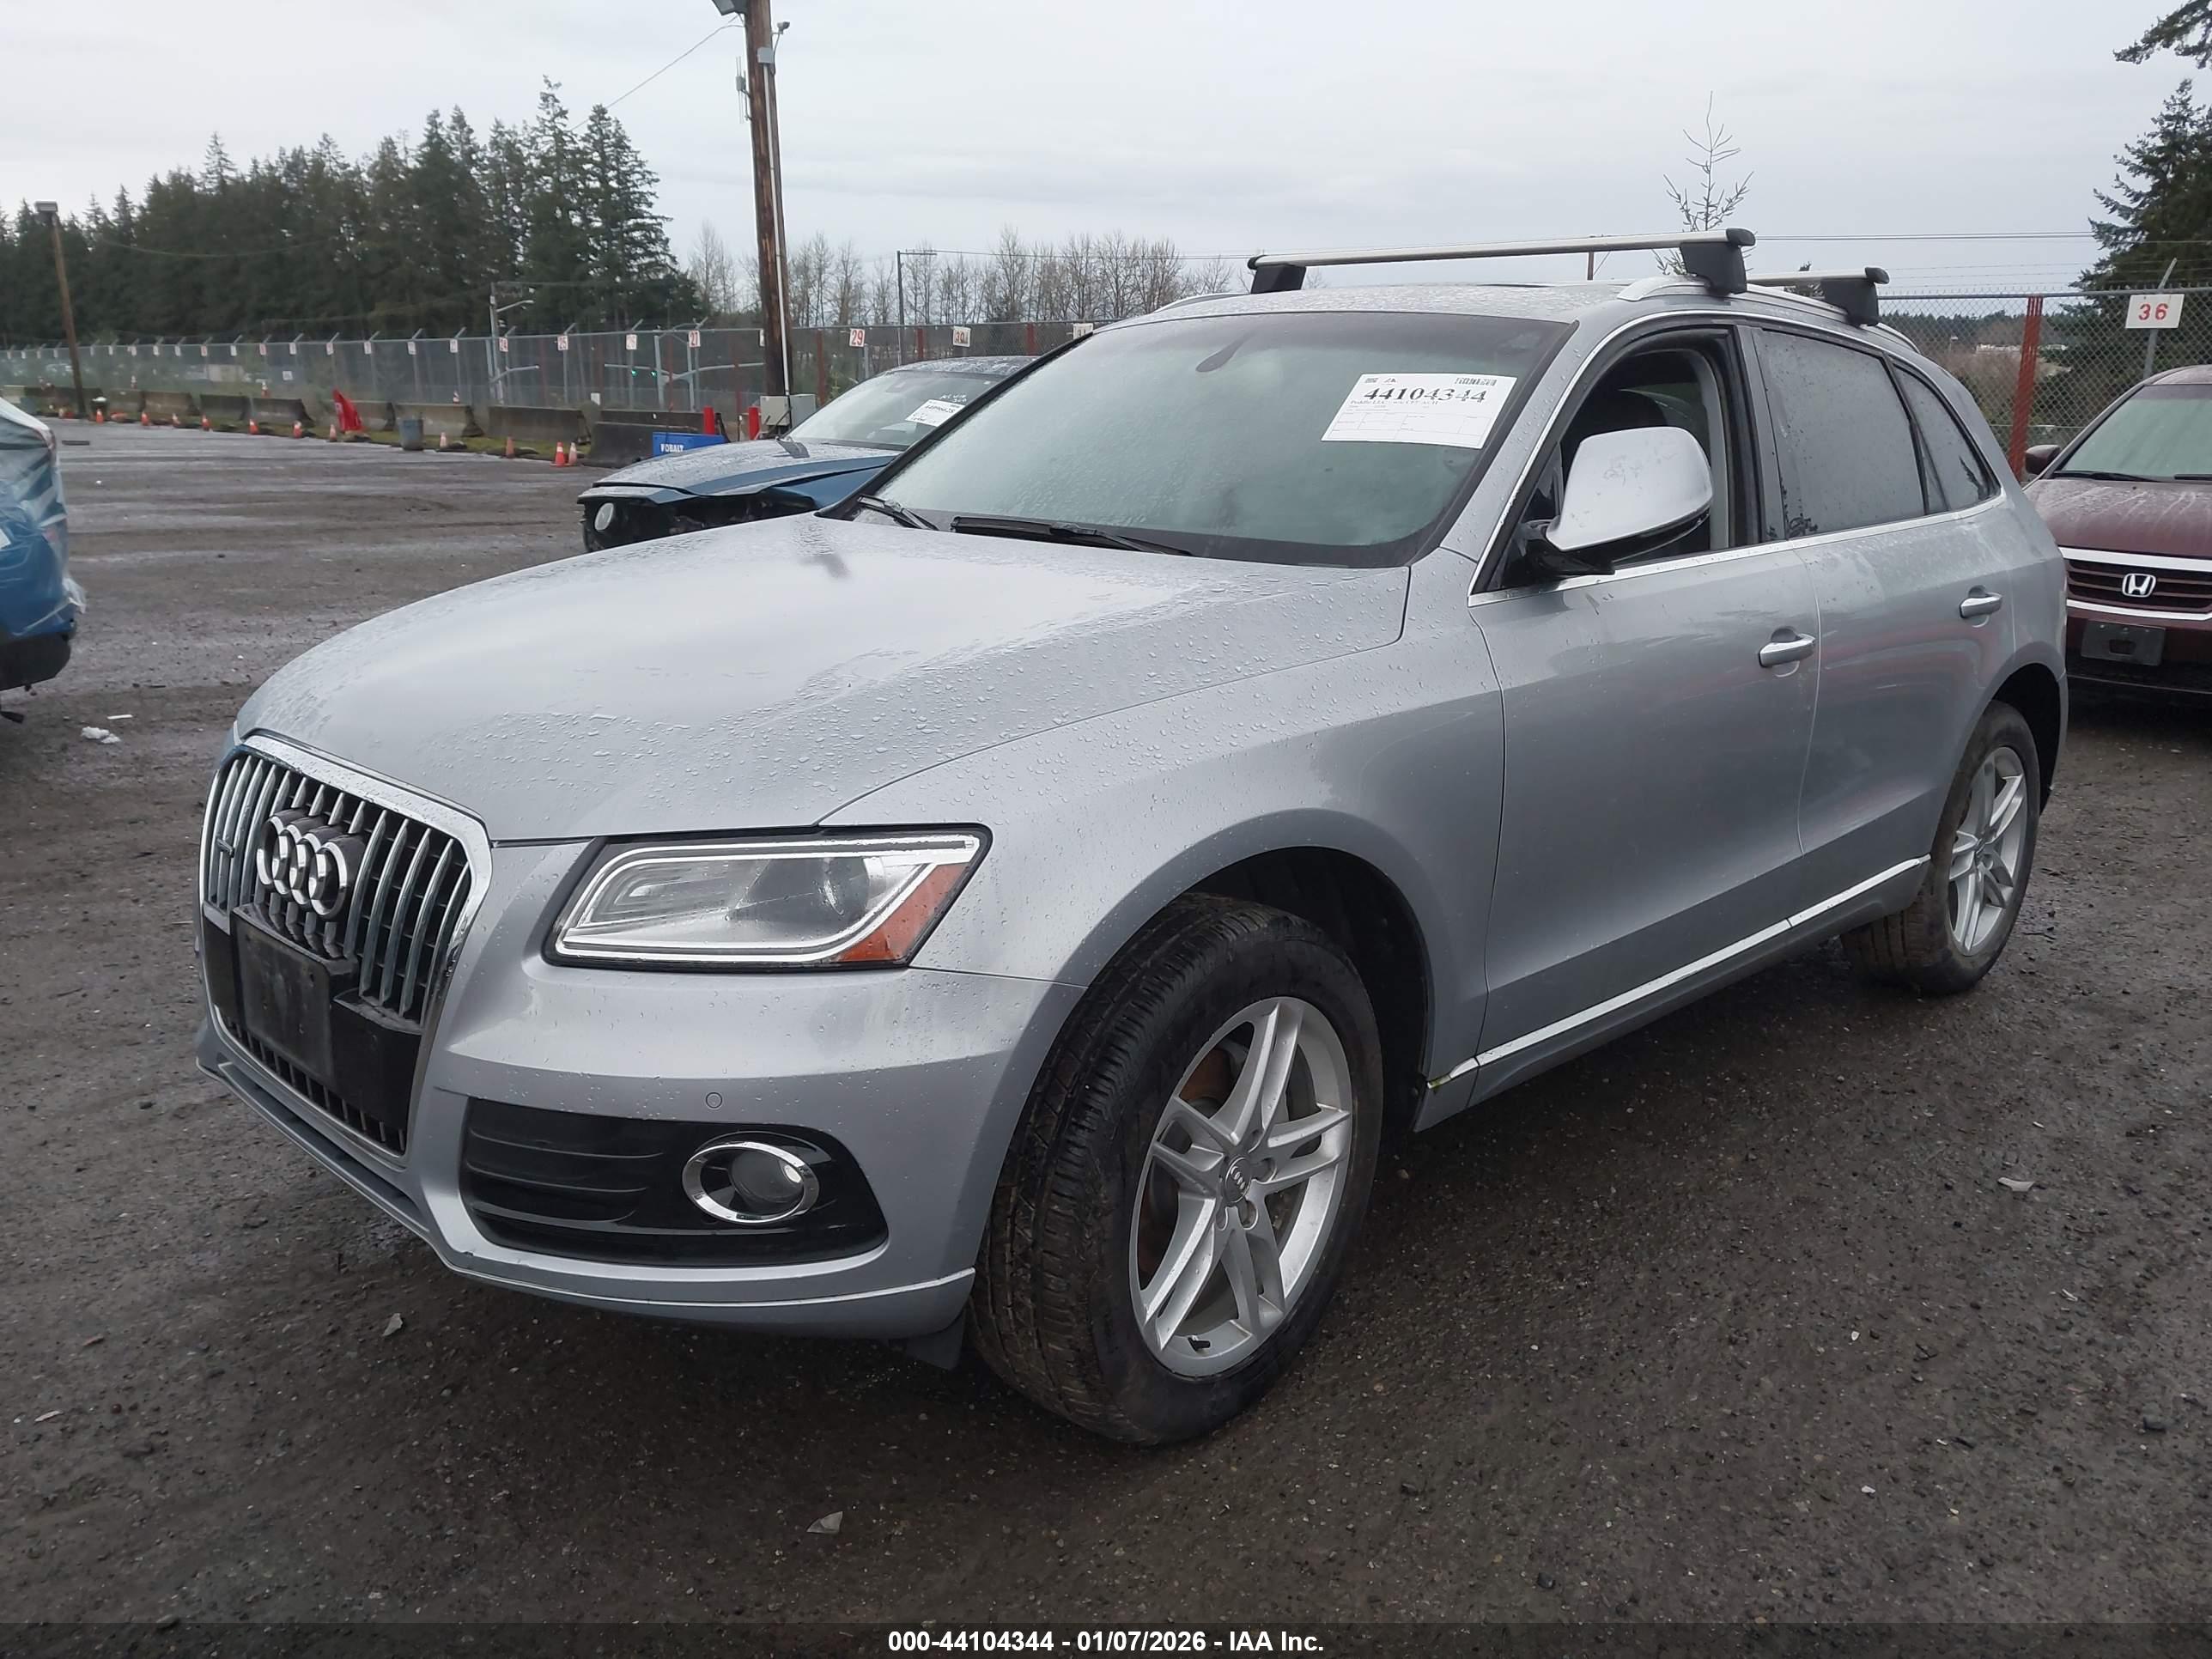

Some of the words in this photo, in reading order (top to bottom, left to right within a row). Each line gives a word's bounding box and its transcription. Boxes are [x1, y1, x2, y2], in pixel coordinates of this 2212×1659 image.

[2139, 303, 2168, 320] 36
[690, 332, 698, 345] 27
[852, 330, 863, 345] 29
[1364, 387, 1486, 403] 44104344
